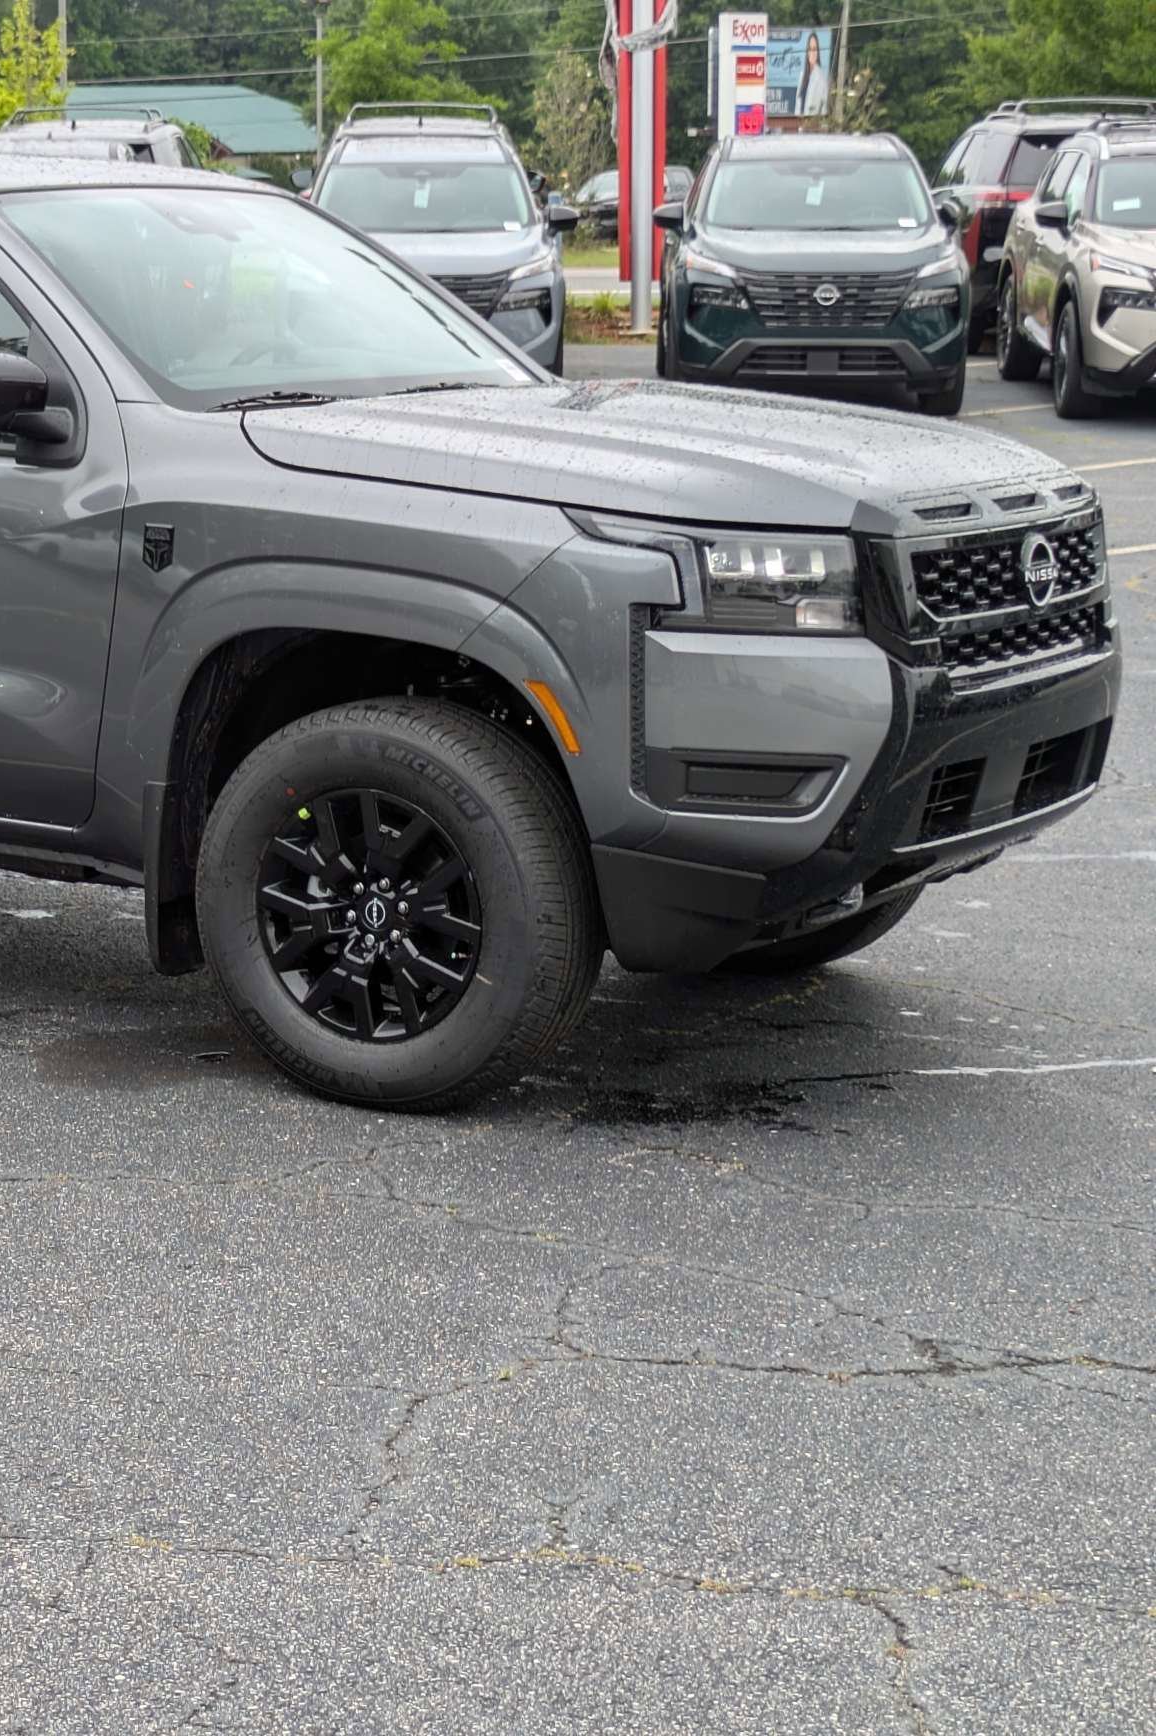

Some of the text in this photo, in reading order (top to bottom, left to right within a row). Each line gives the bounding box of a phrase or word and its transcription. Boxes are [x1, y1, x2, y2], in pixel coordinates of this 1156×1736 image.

[732, 19, 765, 43] Exxon
[1025, 567, 1059, 583] NISS
[384, 746, 481, 817] MICHELIN
